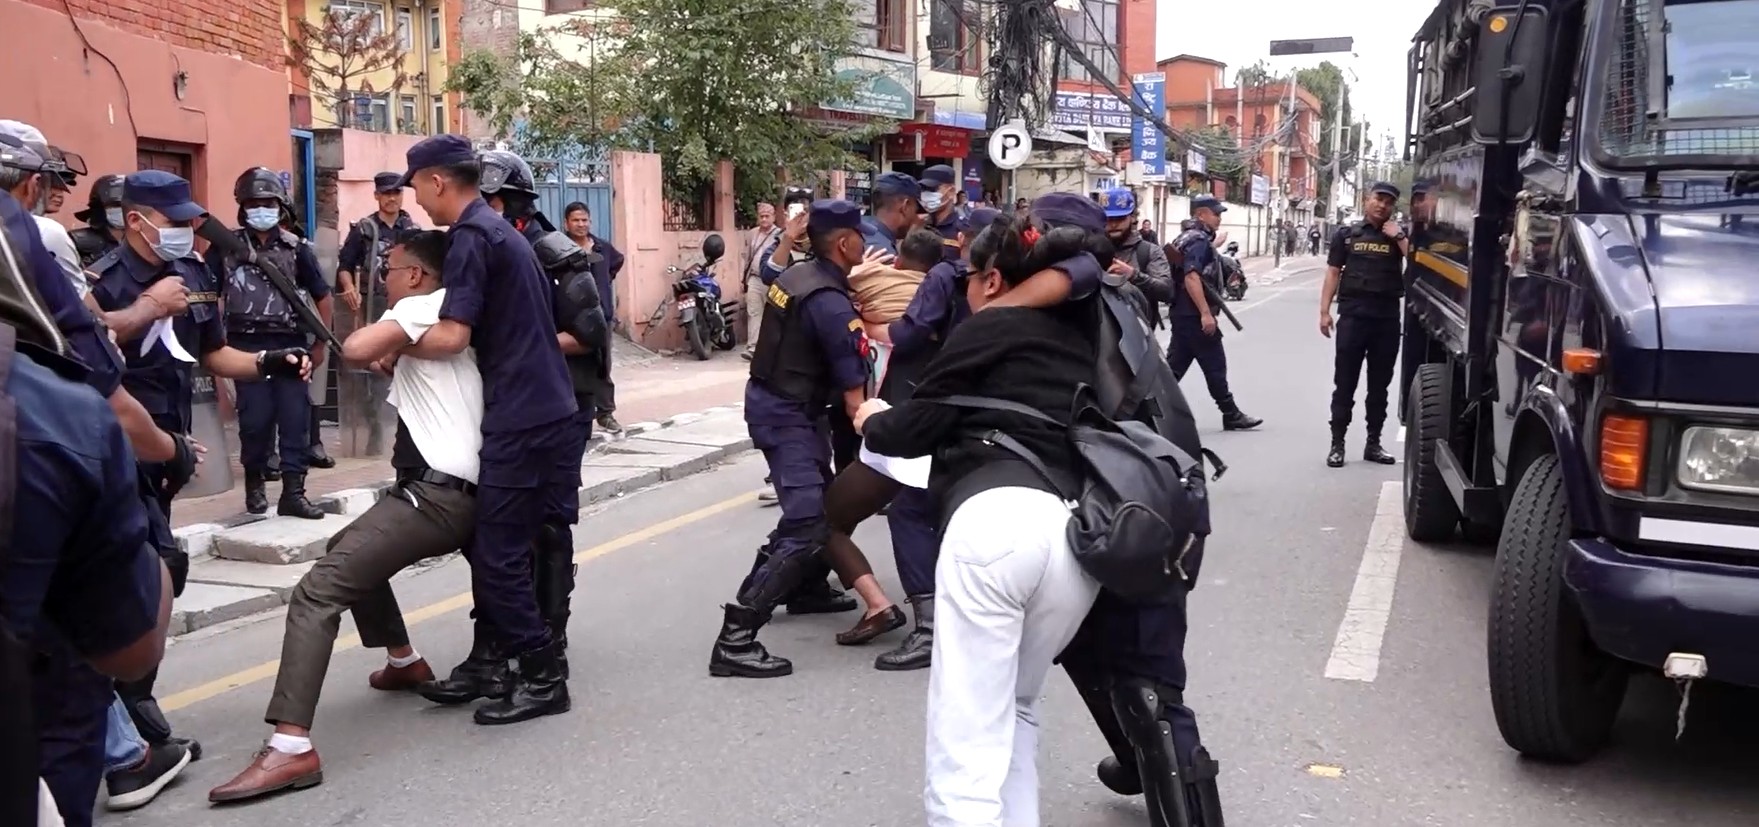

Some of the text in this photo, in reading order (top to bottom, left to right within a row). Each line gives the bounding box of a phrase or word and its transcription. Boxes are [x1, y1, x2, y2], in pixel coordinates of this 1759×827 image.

[1001, 134, 1021, 159] P
[1096, 177, 1116, 189] ATM
[1354, 242, 1390, 253] CITY POLICE
